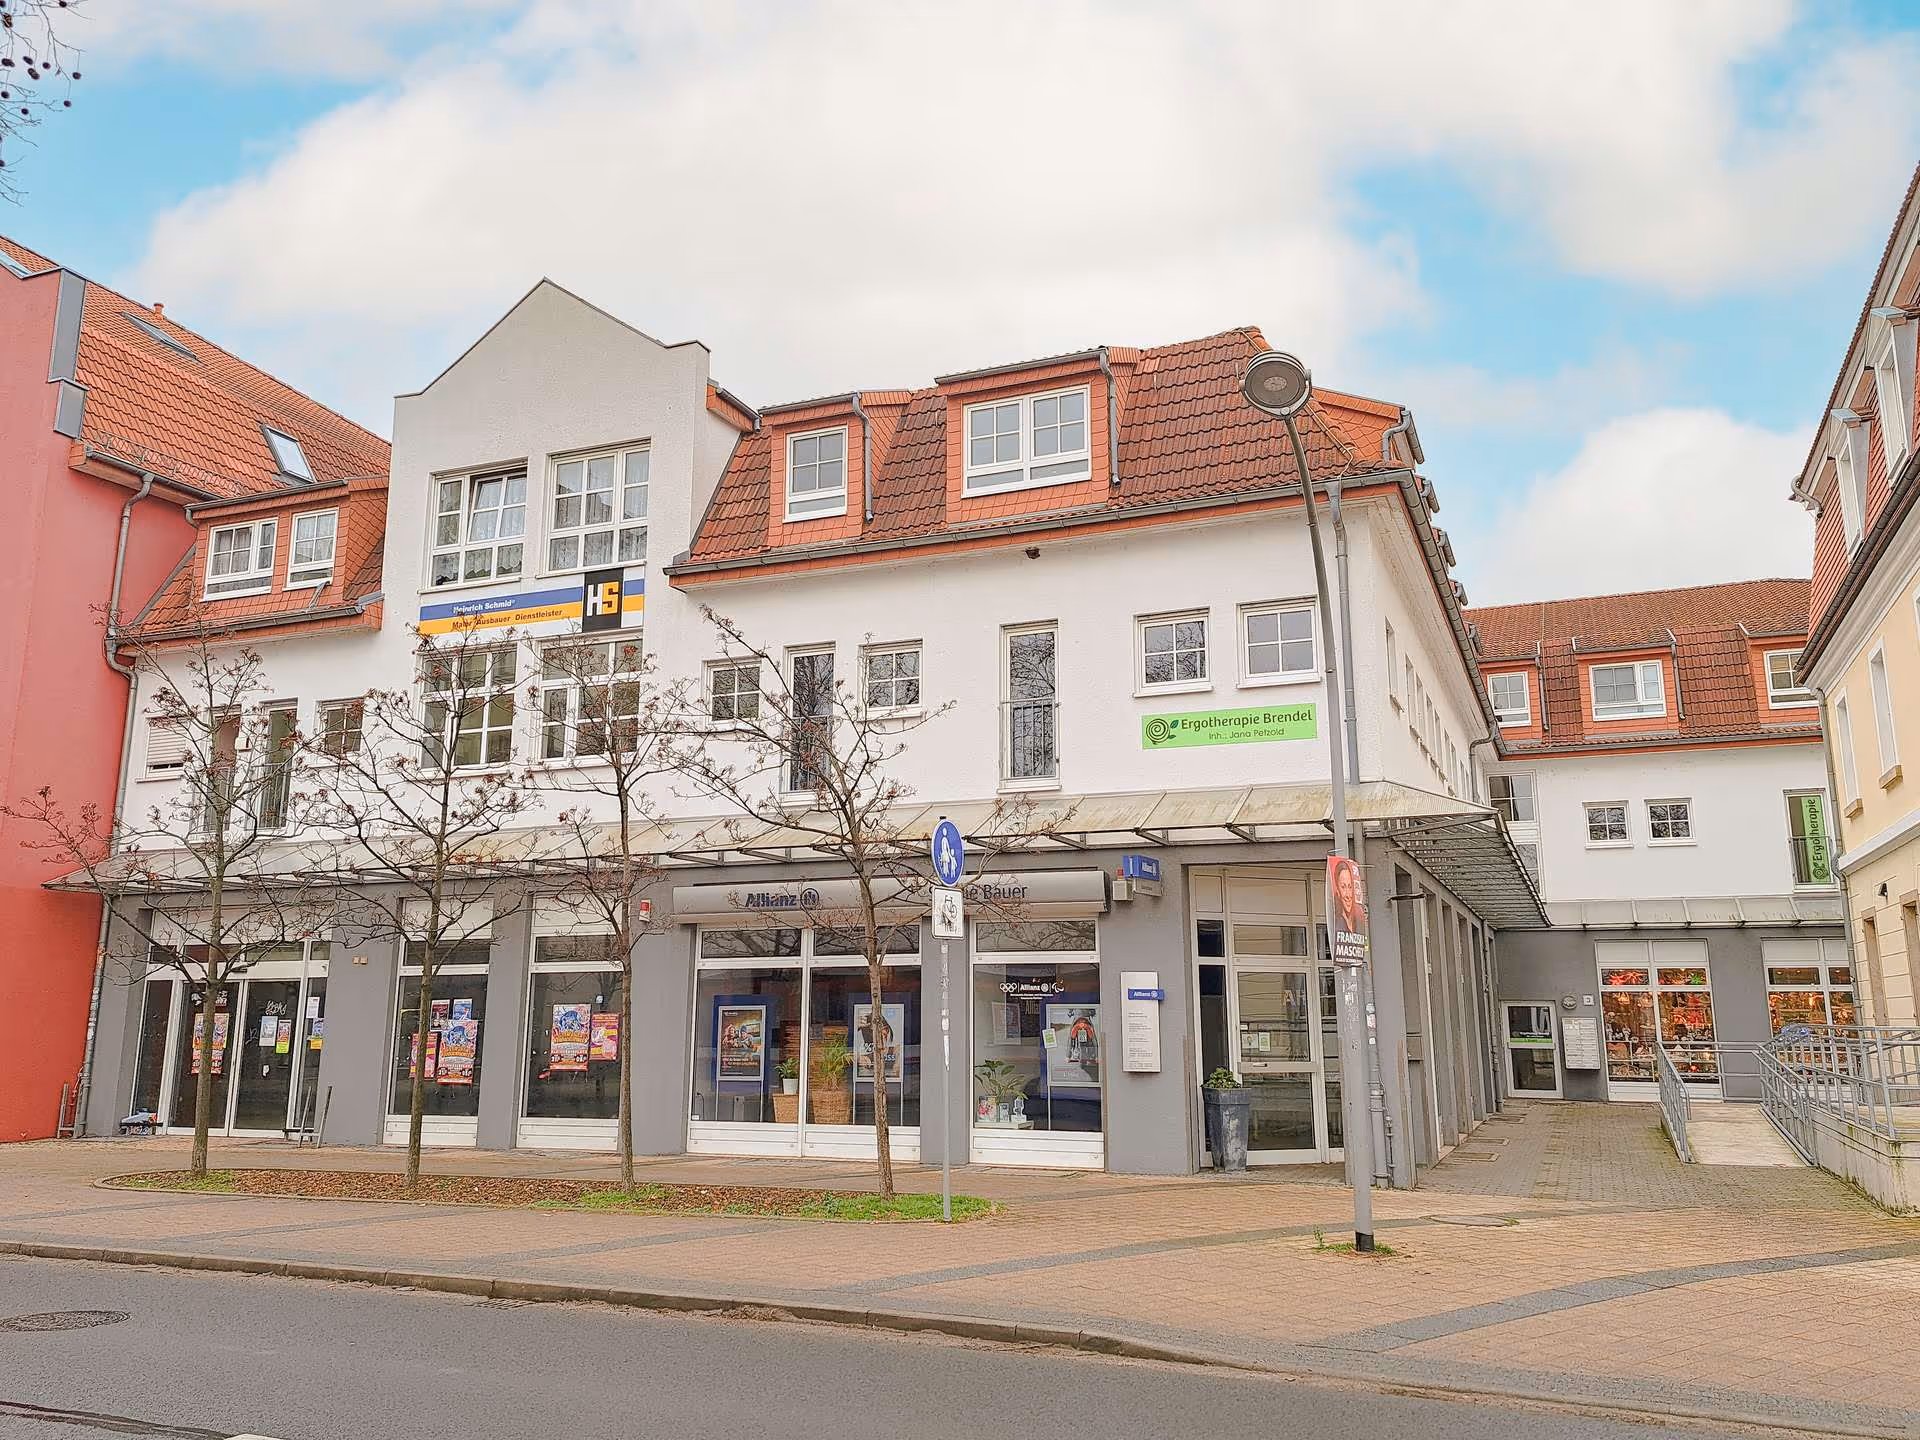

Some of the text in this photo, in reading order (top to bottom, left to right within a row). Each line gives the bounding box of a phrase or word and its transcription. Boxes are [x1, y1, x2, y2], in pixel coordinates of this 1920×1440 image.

[586, 581, 619, 616] HS
[453, 603, 483, 614] Heinrich
[477, 616, 511, 626] Ausbauer
[515, 609, 563, 621] Dienstleister
[1181, 709, 1313, 732] Ergotherapie Brendel
[1229, 730, 1251, 739] Jana
[1253, 728, 1285, 737] Petzold
[745, 892, 797, 907] Allianz
[983, 884, 1028, 900] Bauer
[1020, 983, 1041, 991] Allianz
